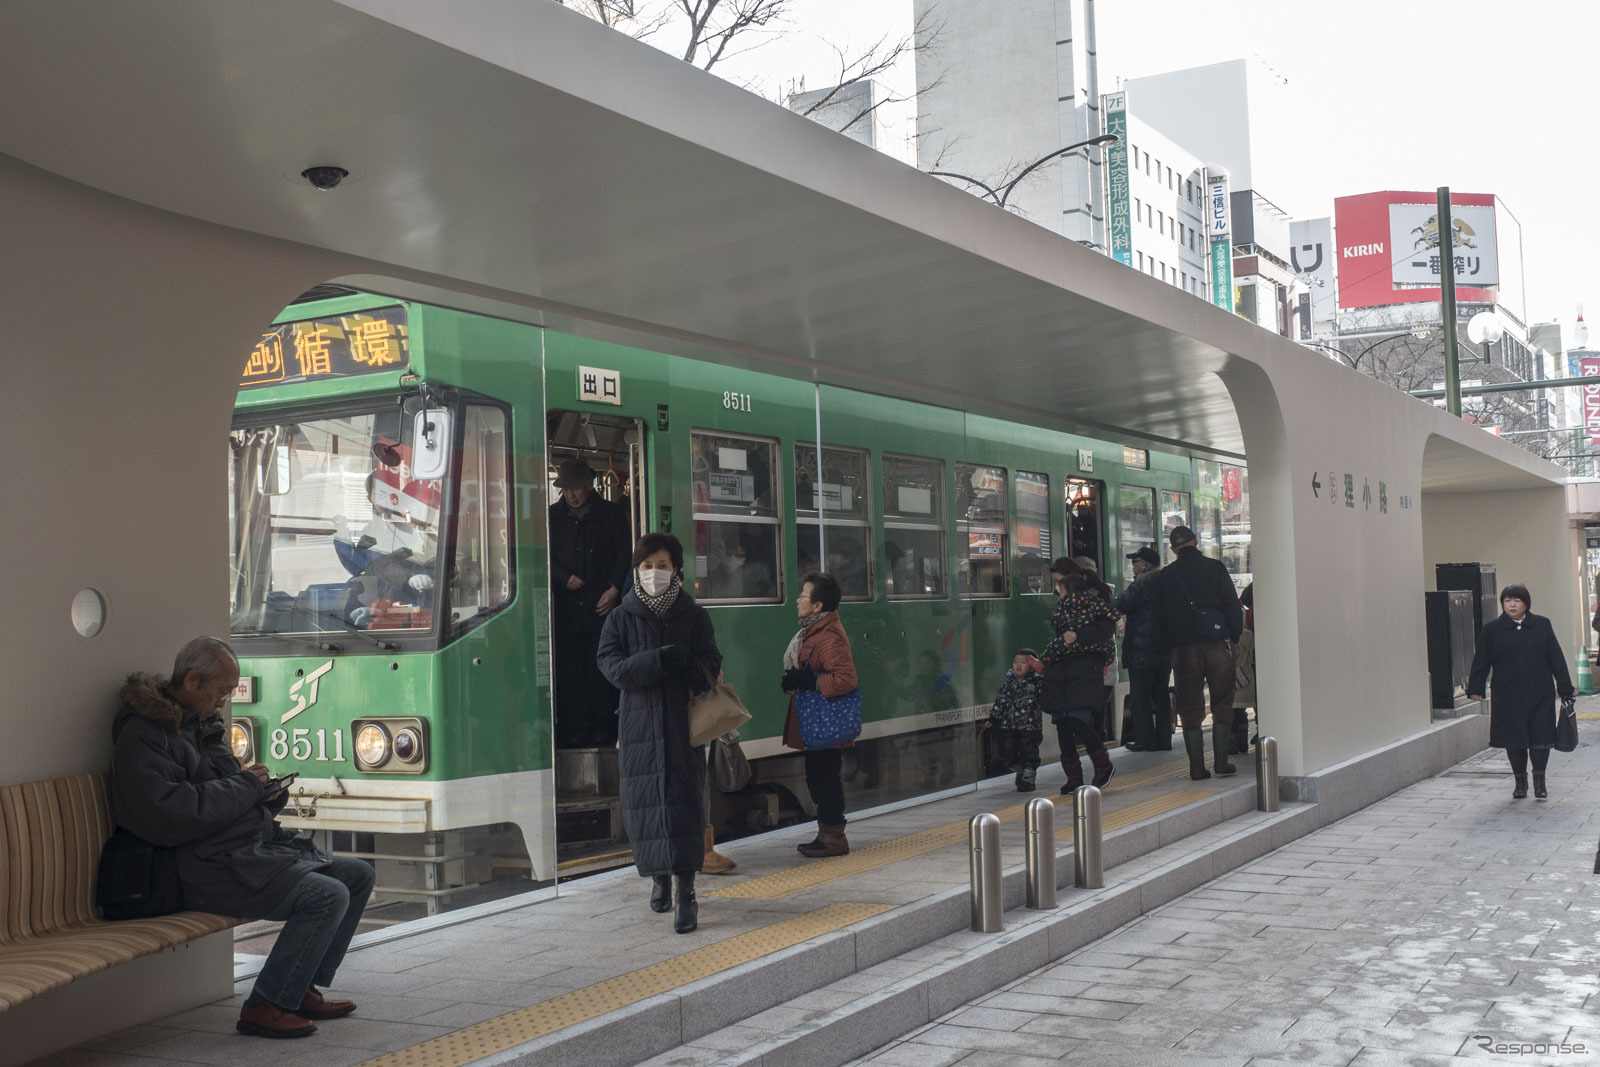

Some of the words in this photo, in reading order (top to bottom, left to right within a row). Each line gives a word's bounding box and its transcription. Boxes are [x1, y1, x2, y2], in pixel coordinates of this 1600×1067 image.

[1108, 97, 1124, 109] 7F
[1109, 118, 1130, 249] 大塚美容形成外科
[1213, 185, 1226, 229] 三信ビル
[1343, 242, 1384, 258] KIRIN
[242, 341, 281, 377] 回り
[294, 319, 394, 376] 循環
[584, 373, 616, 398] 出口
[723, 391, 752, 412] 8511
[1080, 453, 1092, 467] 入口
[270, 728, 346, 762] 8511
